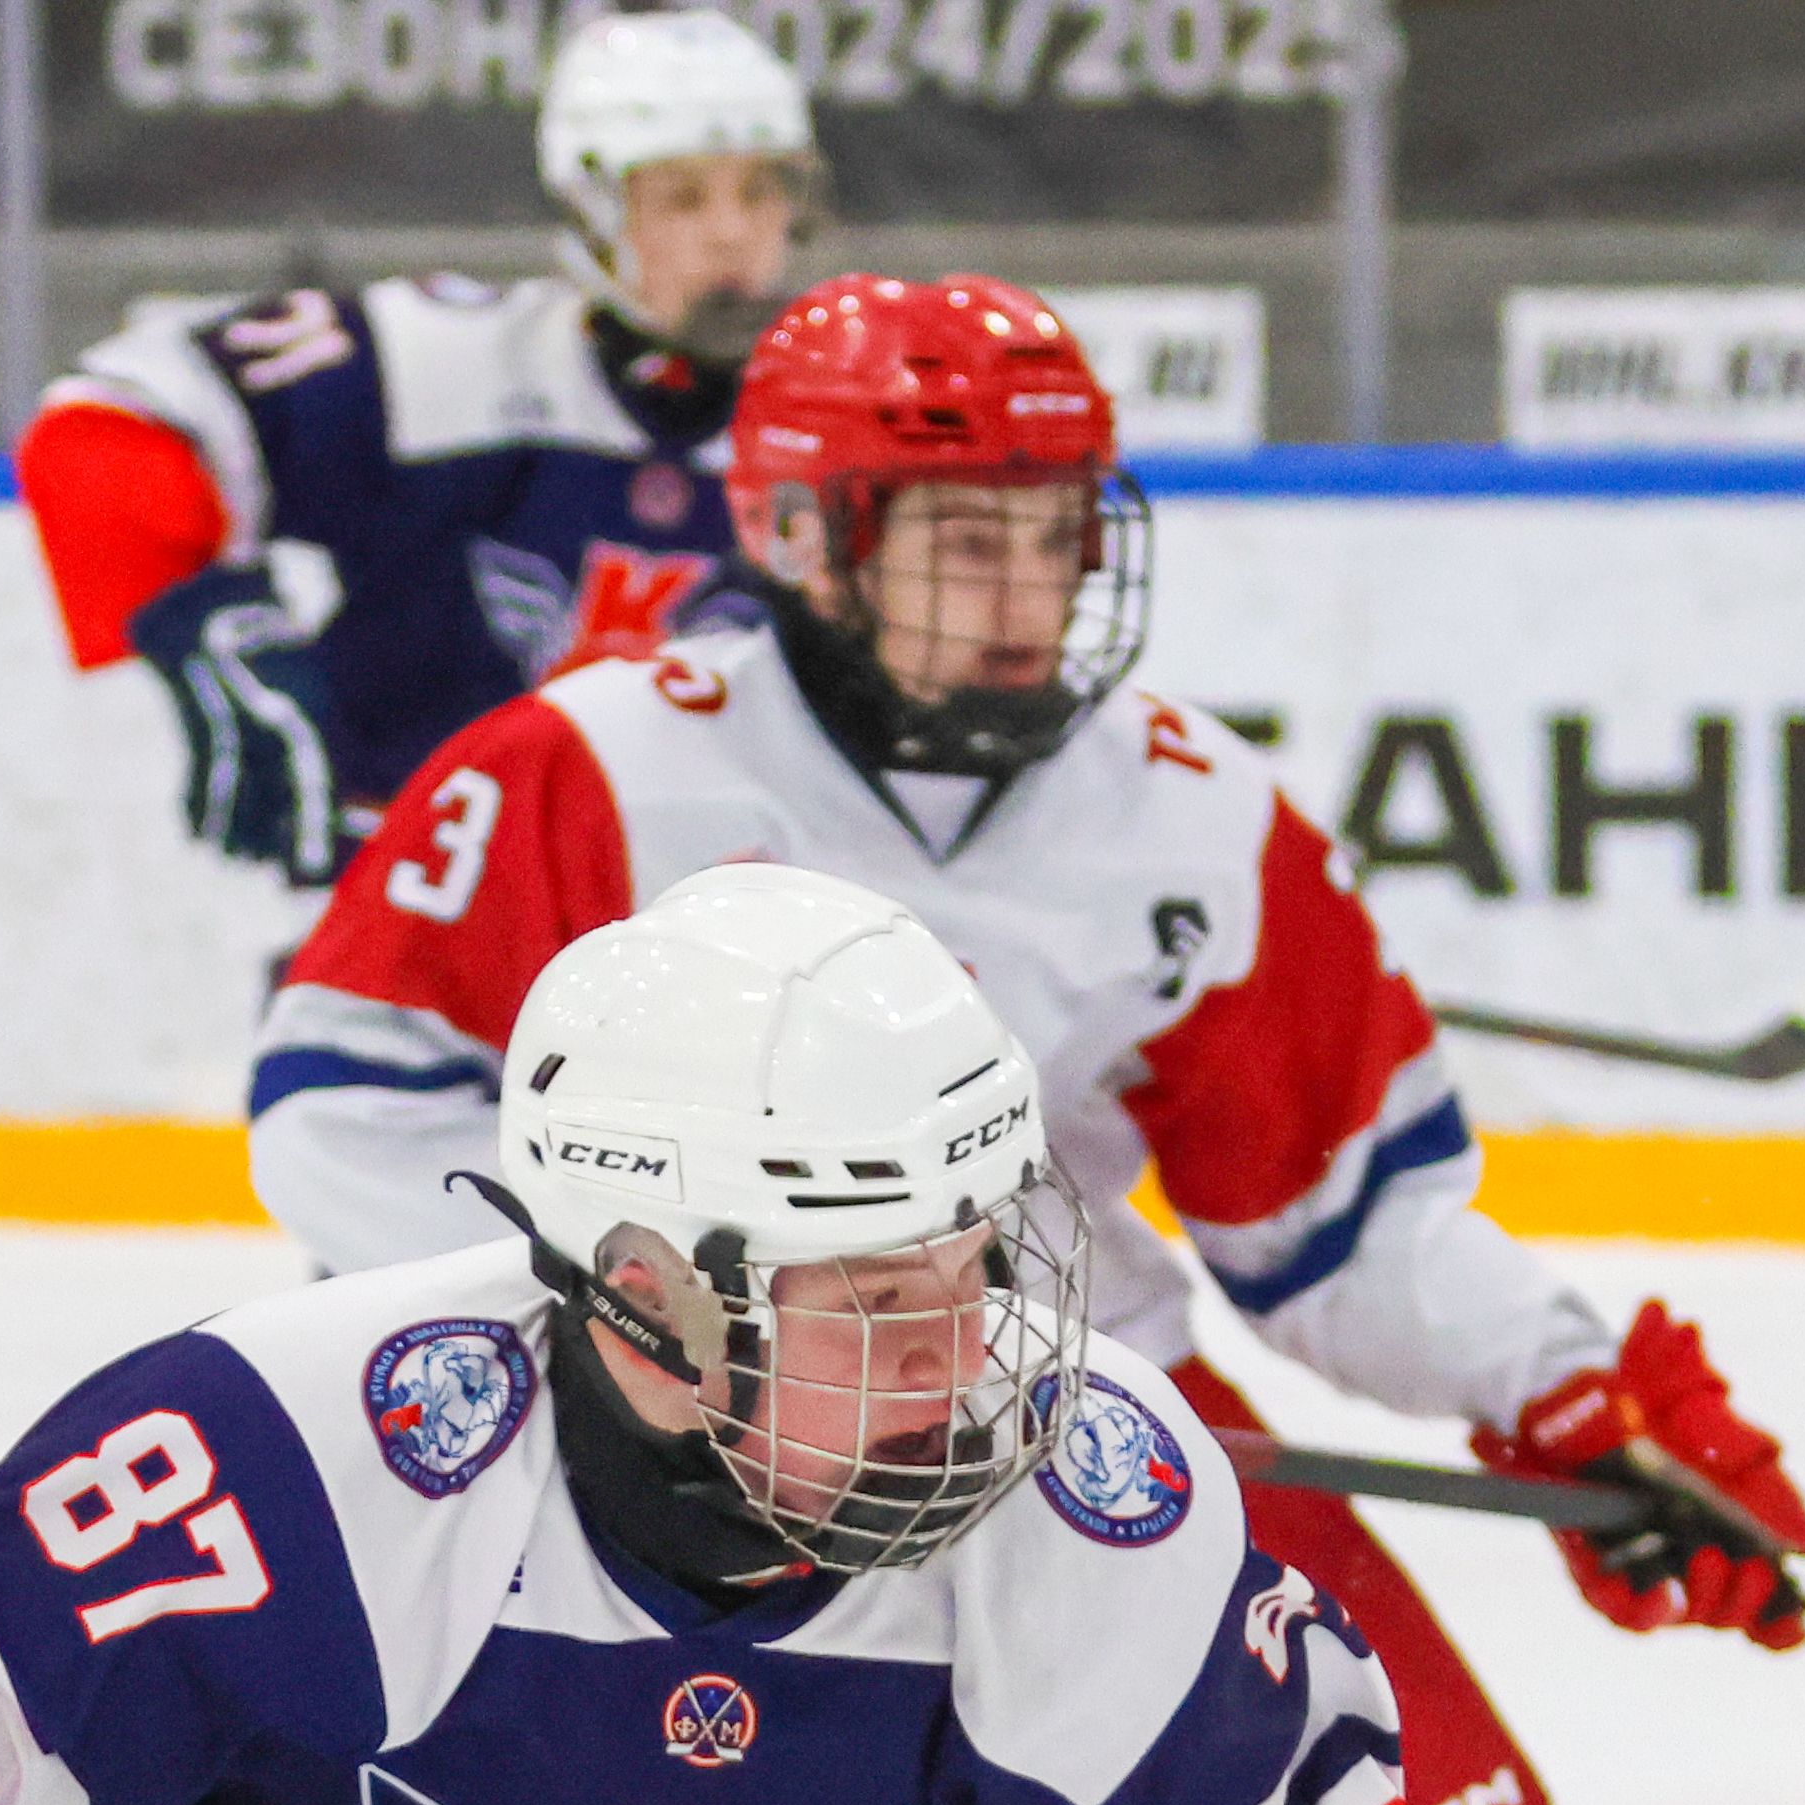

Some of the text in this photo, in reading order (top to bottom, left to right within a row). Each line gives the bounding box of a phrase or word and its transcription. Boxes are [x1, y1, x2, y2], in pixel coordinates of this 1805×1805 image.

[107, 0, 1403, 107] СЕЗОН 024/2025
[387, 766, 503, 923] 3
[559, 1141, 669, 1178] CCM
[944, 1096, 1030, 1166] CCM
[20, 1408, 273, 1644] 87
